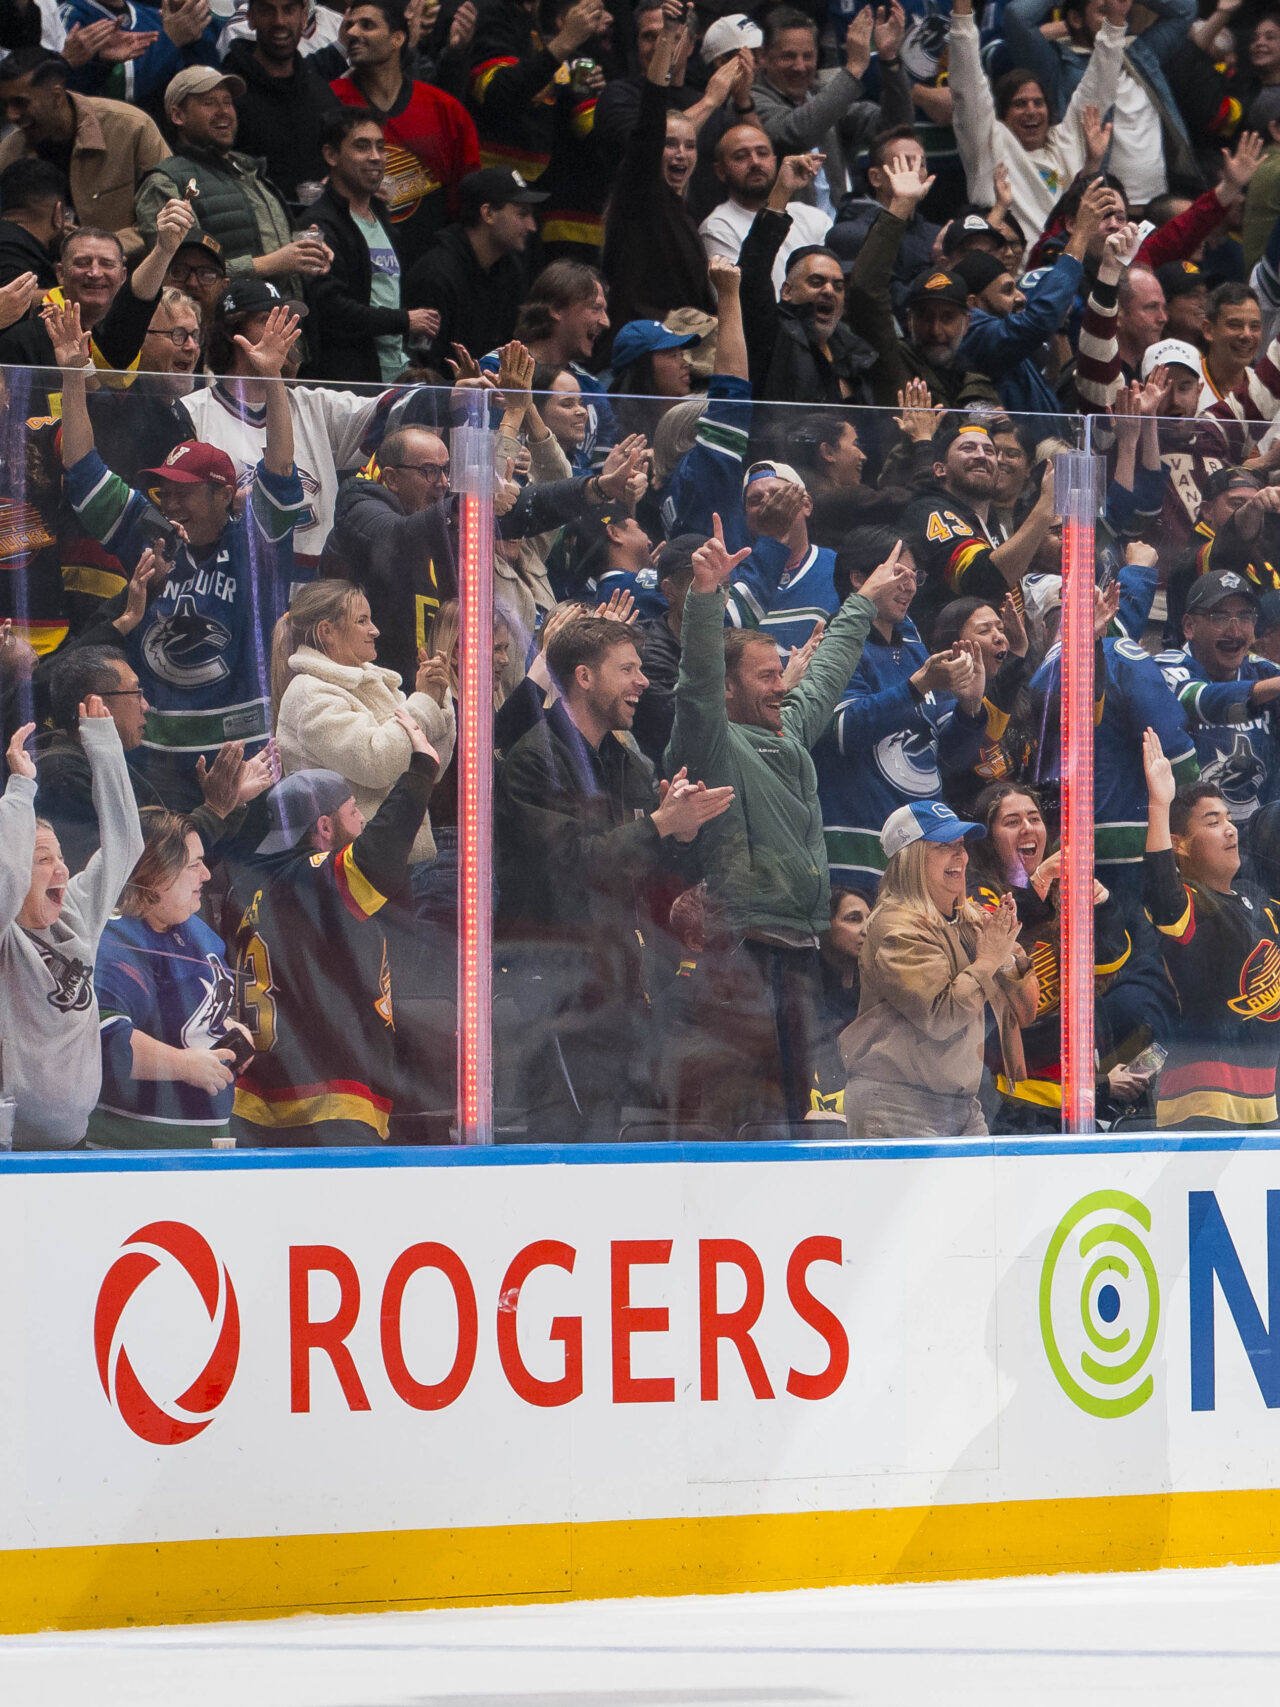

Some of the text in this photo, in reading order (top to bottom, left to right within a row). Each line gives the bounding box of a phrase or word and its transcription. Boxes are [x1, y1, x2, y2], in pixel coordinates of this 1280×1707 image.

[926, 509, 975, 543] 43
[236, 931, 279, 1053] 3
[289, 1235, 850, 1414] ROGERS
